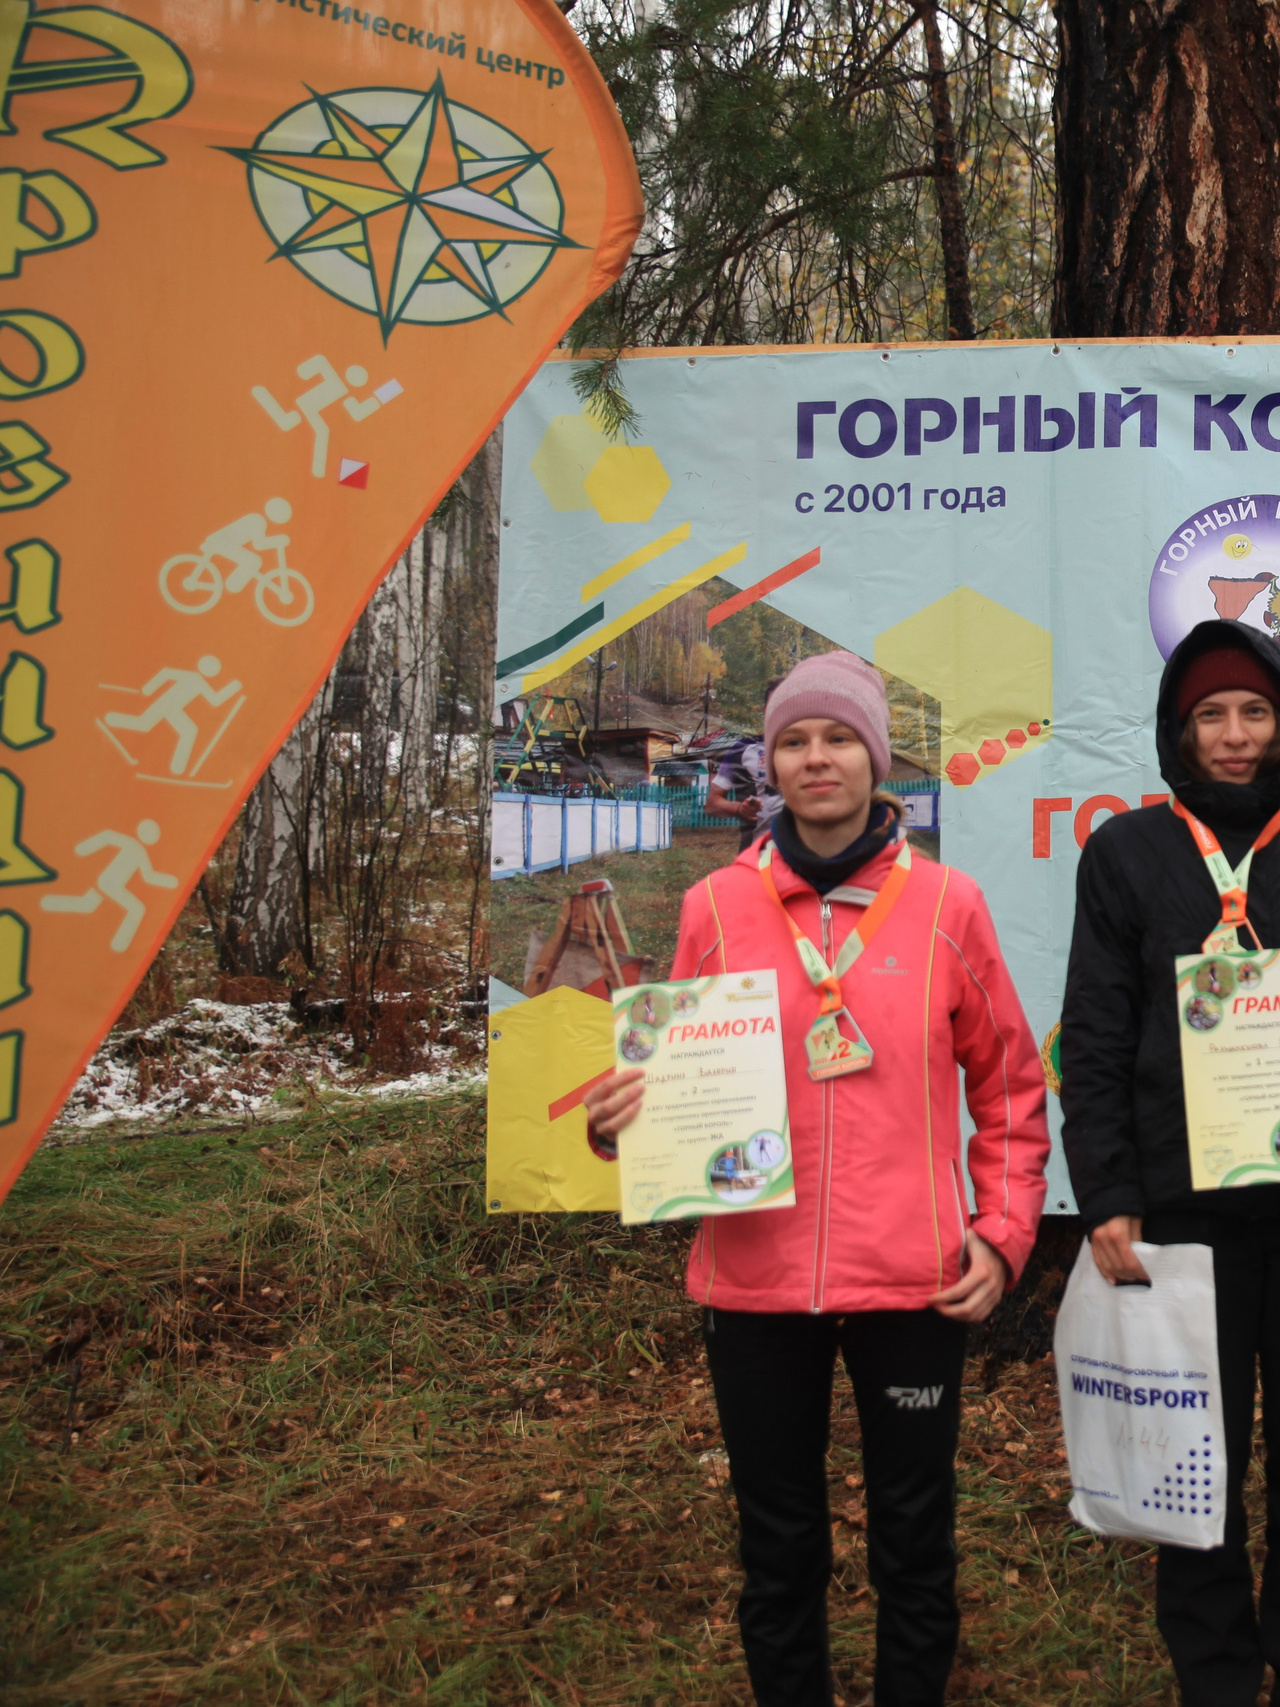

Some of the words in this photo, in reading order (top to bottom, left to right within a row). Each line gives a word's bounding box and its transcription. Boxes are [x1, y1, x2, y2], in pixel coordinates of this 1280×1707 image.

[476, 46, 566, 89] центр
[797, 387, 1157, 459] ГОРНЫЙ
[795, 492, 814, 513] с
[824, 483, 911, 513] 2001
[924, 486, 1006, 514] года
[1159, 496, 1258, 576] ГОРНЫЙ
[668, 1016, 776, 1044] ГРАМОТА
[837, 1040, 852, 1058] 2
[1072, 1372, 1209, 1409] WINTERSPORT
